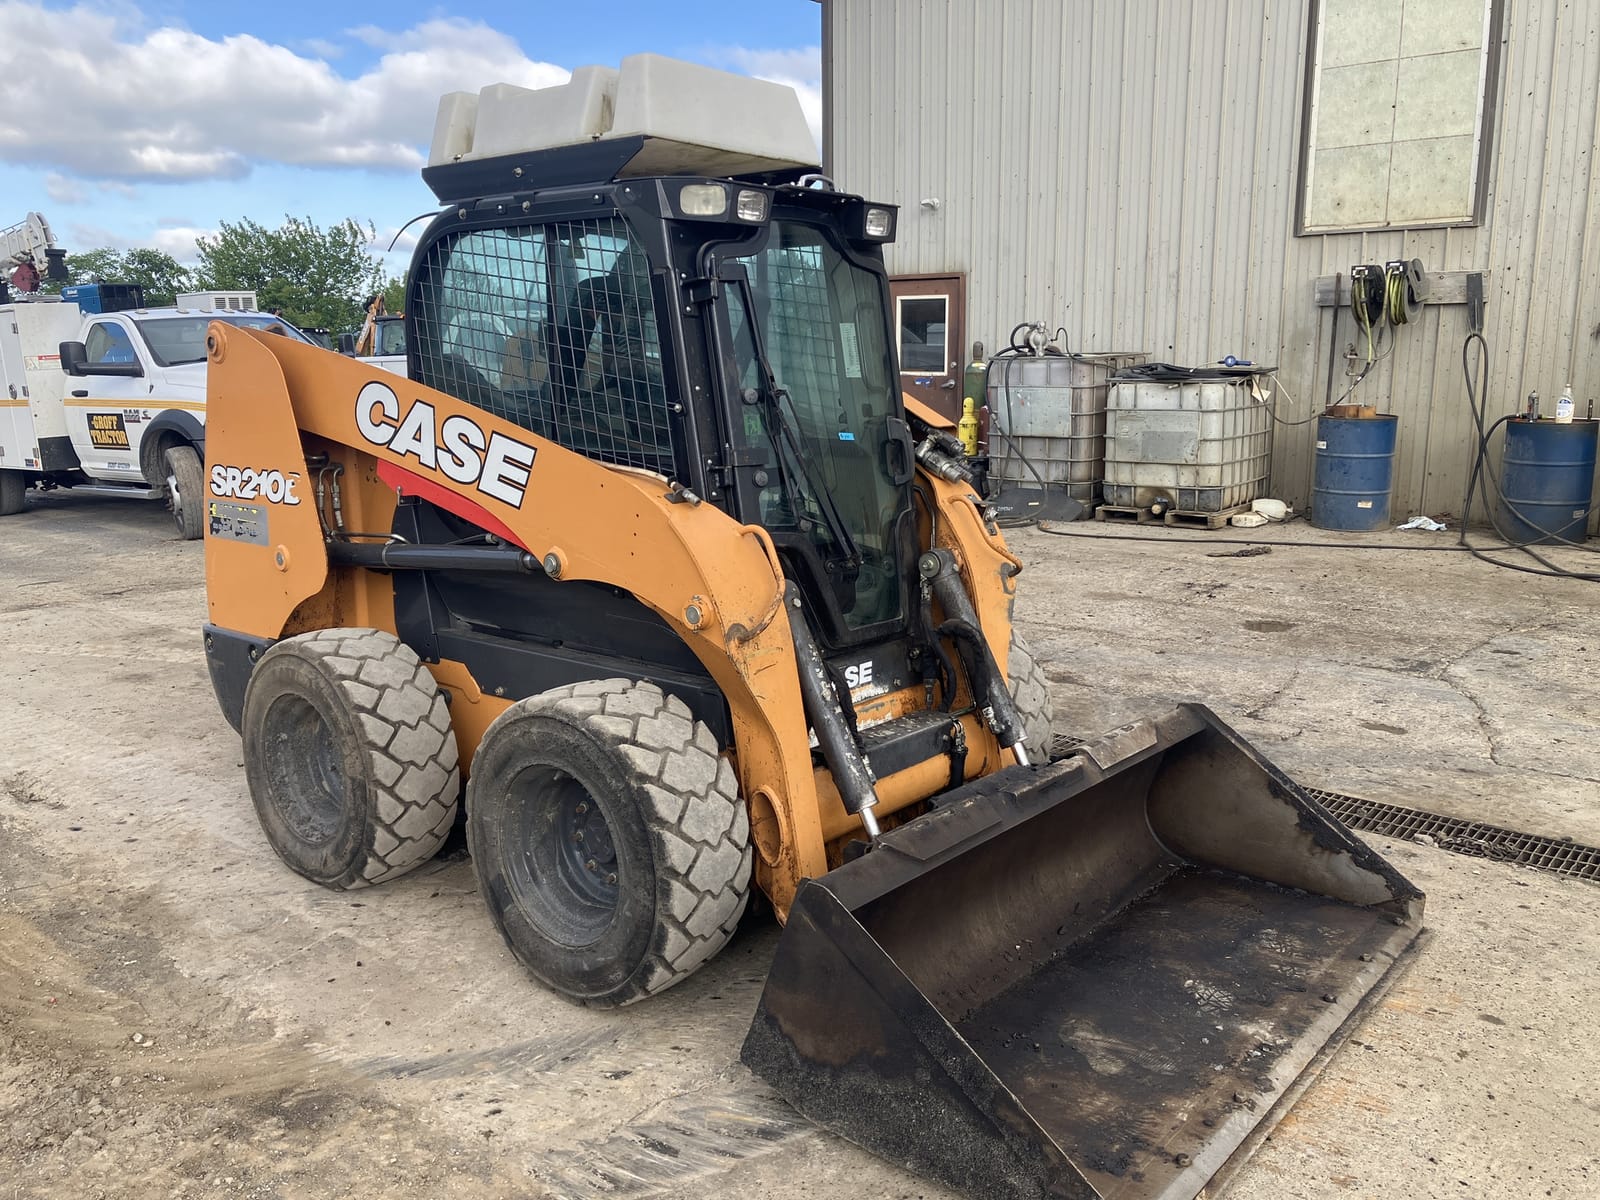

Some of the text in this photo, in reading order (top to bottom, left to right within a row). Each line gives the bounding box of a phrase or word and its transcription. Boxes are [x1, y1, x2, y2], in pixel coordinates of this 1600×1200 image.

[92, 415, 118, 430] GROFF
[90, 430, 128, 445] TRACTOR
[355, 381, 538, 510] CASE
[844, 661, 873, 689] SE
